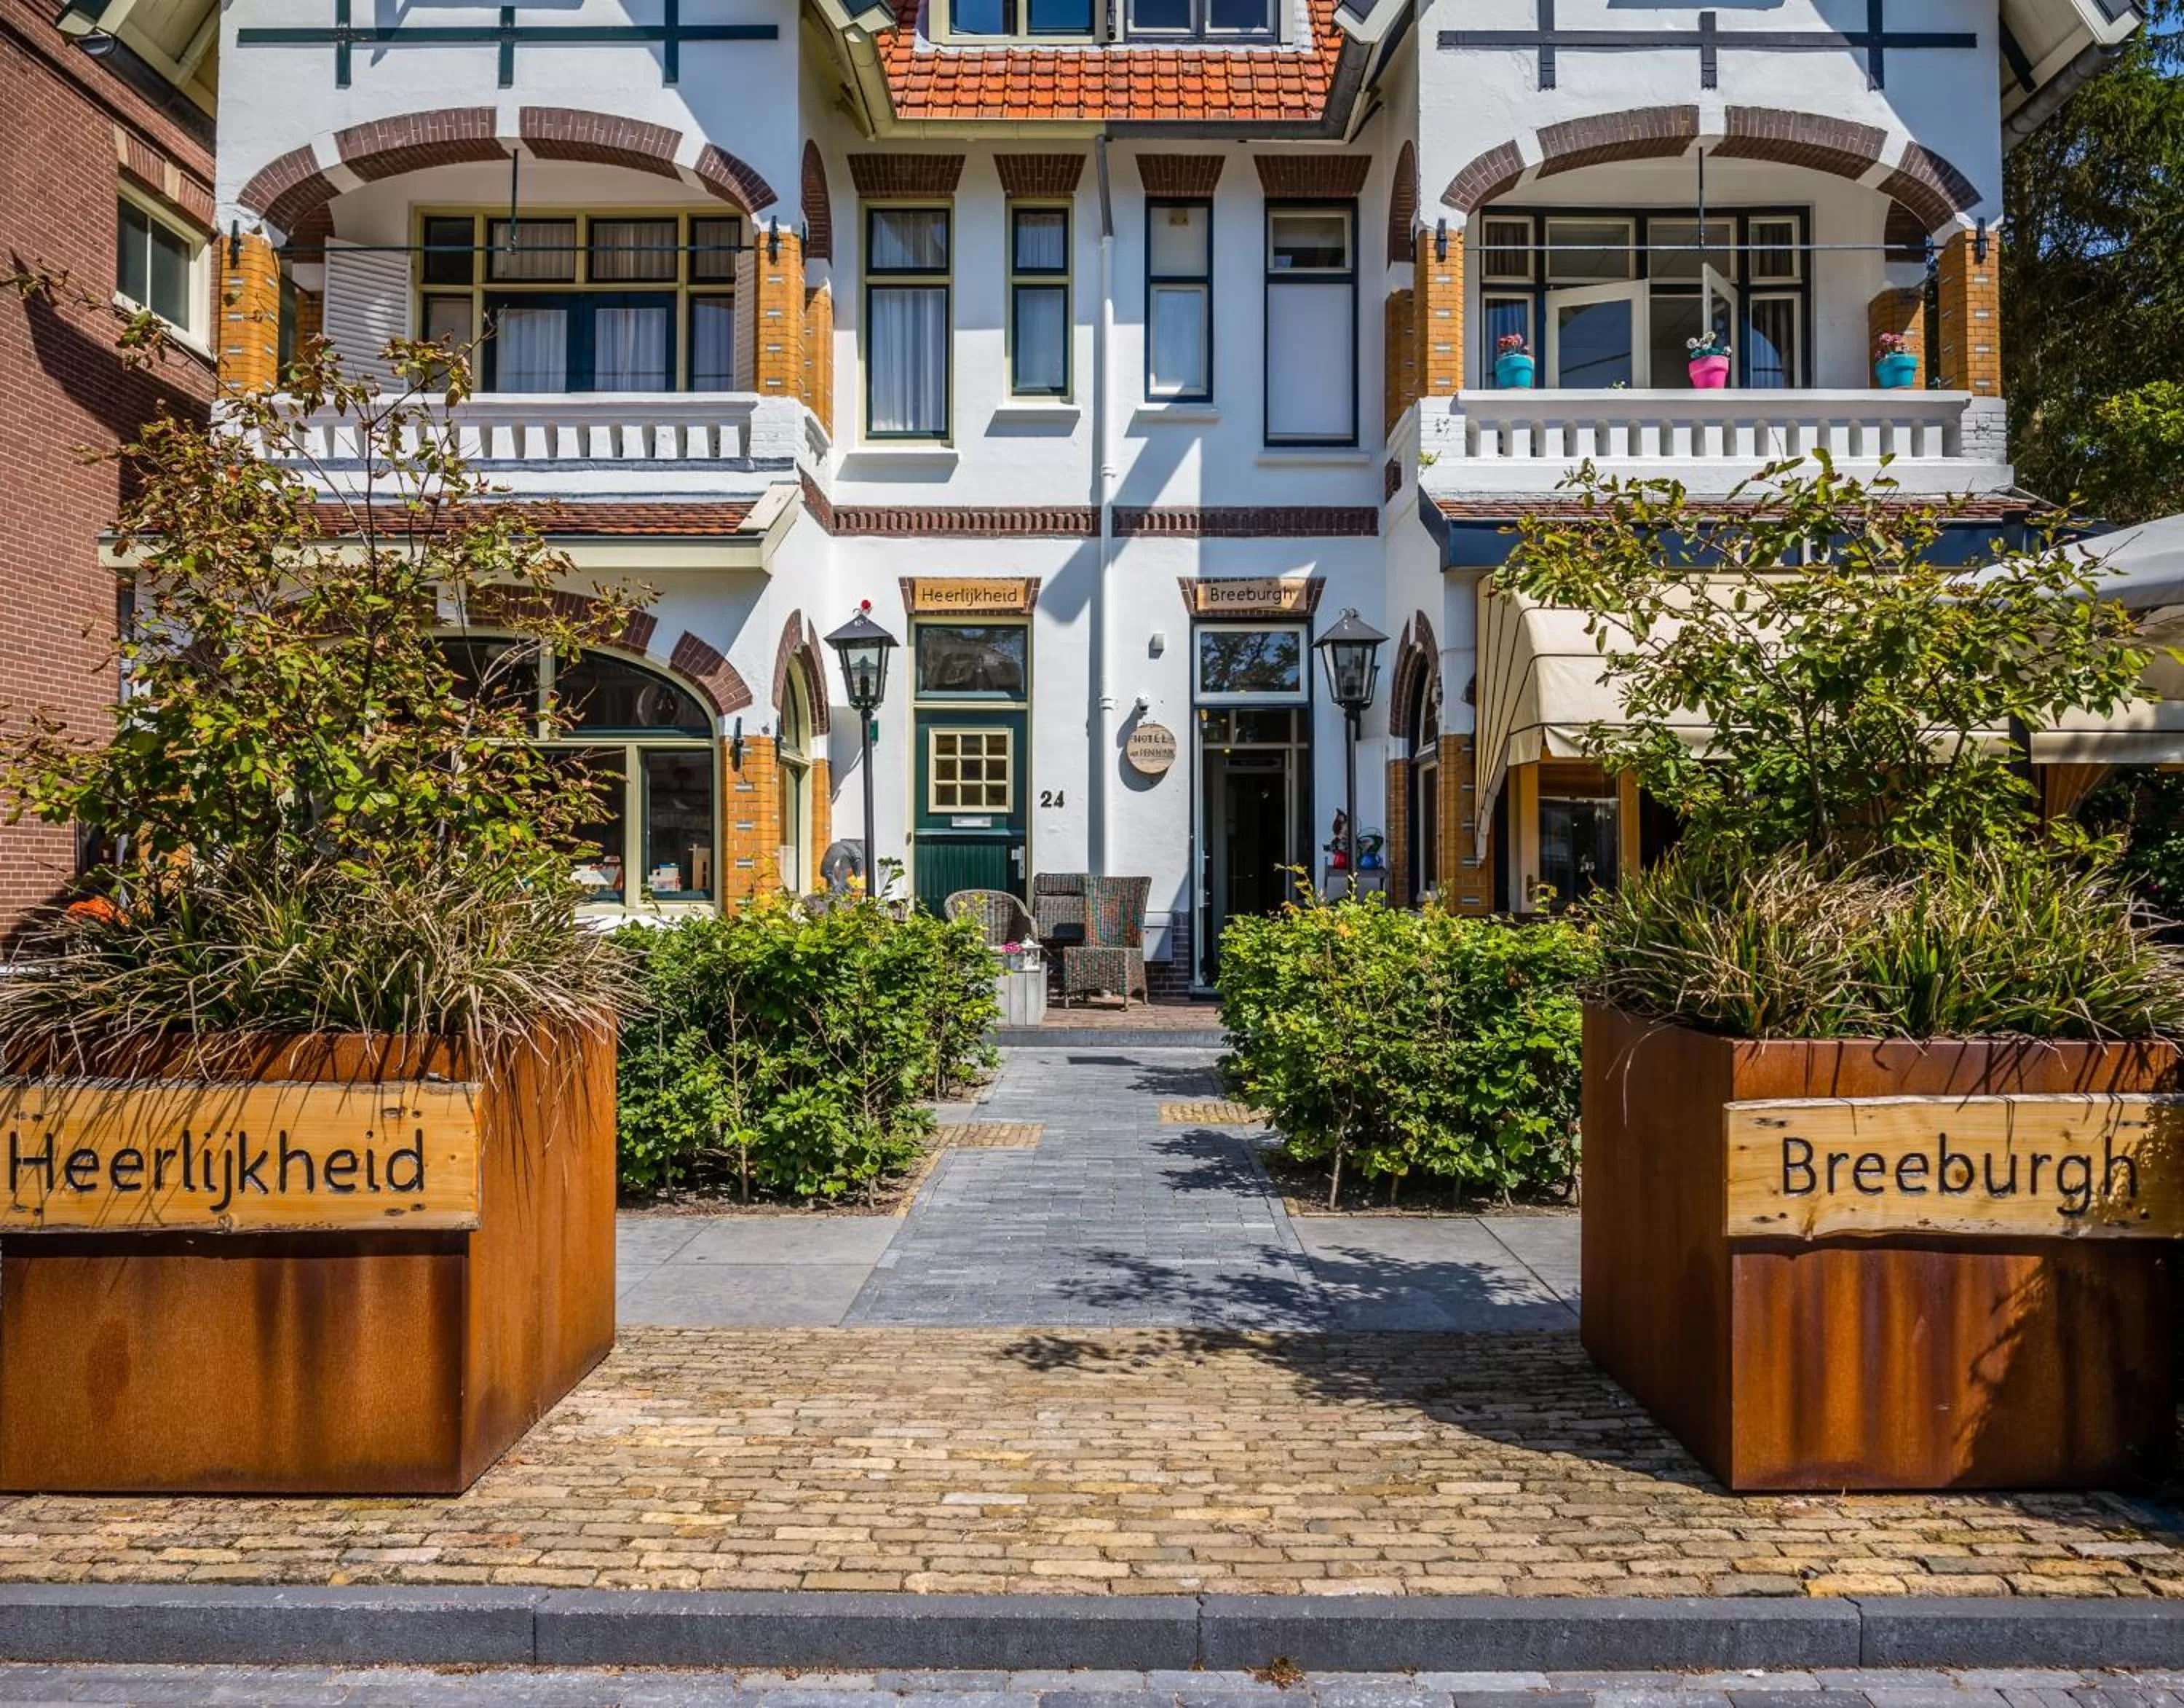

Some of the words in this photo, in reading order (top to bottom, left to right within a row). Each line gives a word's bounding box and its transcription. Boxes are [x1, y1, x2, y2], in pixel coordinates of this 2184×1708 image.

[922, 588, 1017, 606] Heerlijkheid
[1211, 586, 1292, 604] Breeburgh
[1040, 791, 1065, 807] 24
[8, 1128, 424, 1212] Heerlijkheid
[1781, 1132, 2139, 1215] Breeburgh
